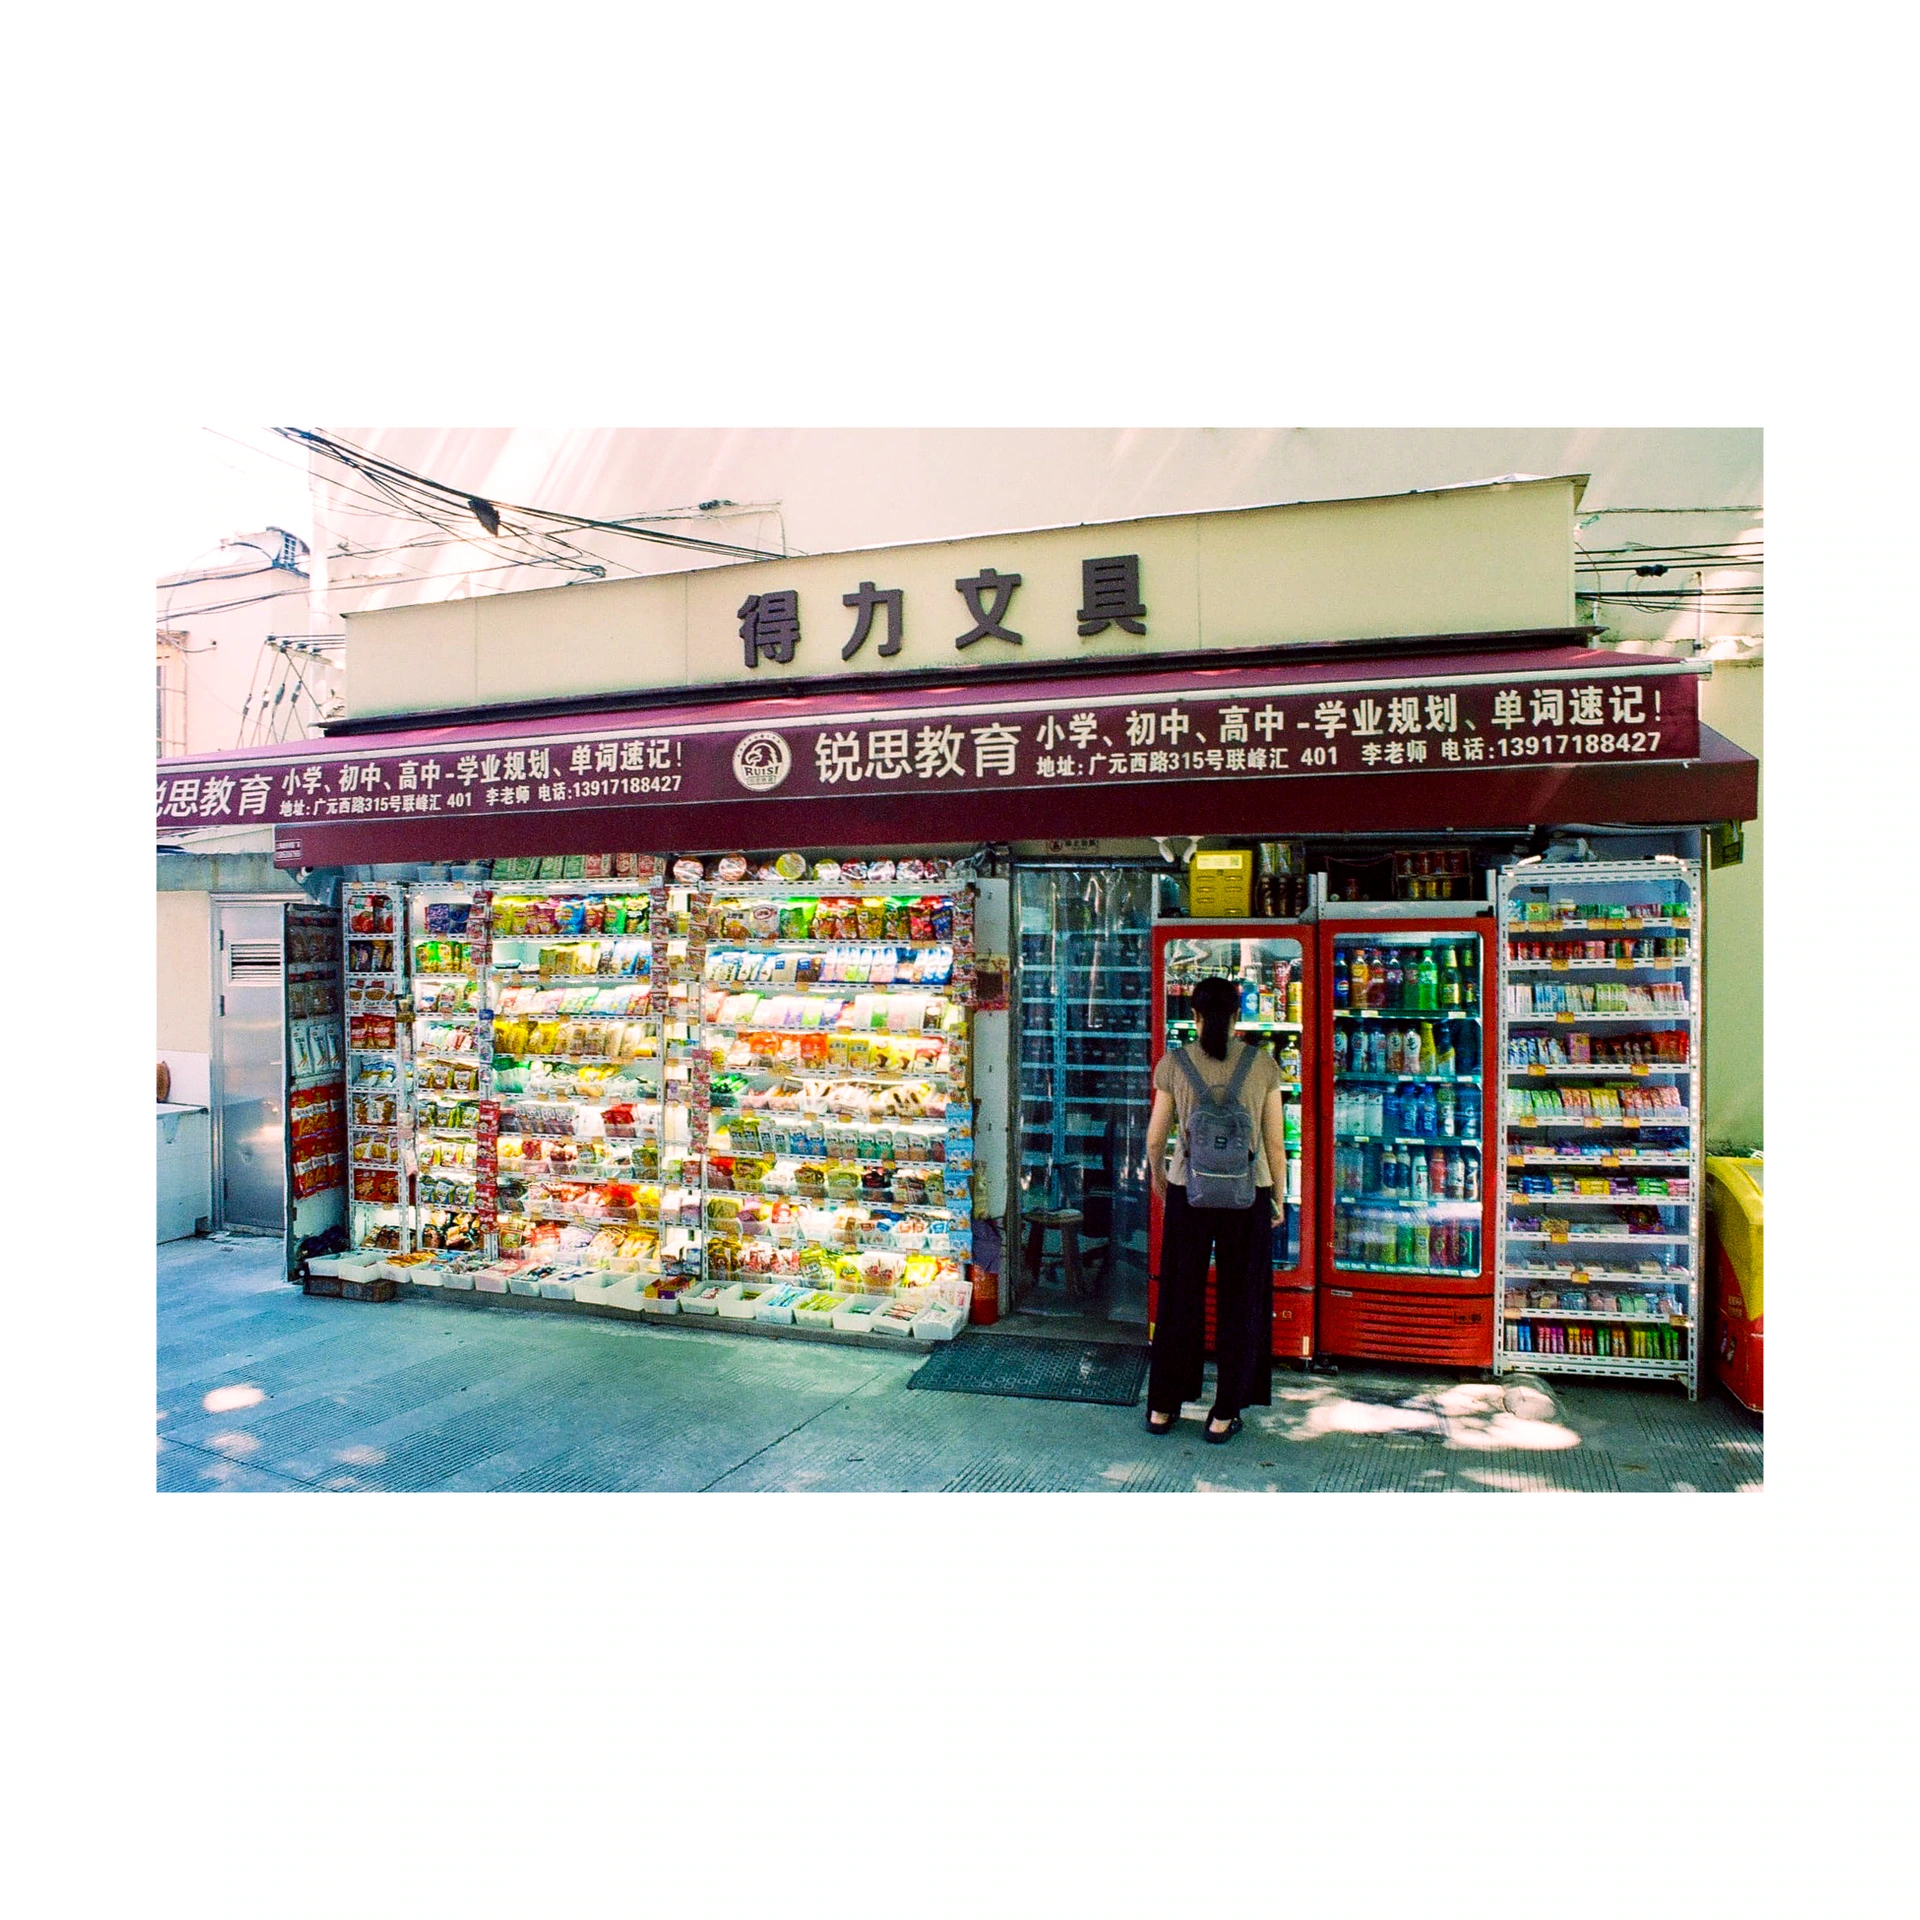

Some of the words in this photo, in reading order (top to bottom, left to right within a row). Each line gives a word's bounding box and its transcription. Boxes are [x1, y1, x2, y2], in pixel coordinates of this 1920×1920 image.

[737, 555, 1147, 668] 得力文具
[744, 765, 780, 777] RUISI
[815, 724, 1021, 784] 锐思教育
[1037, 747, 1289, 777] 地址:广元西路315号联峰汇
[1300, 747, 1337, 766] 401
[1361, 739, 1427, 766] 李老师
[1441, 731, 1661, 762] 电话:13917188427
[446, 792, 472, 809] 401
[485, 784, 530, 805] 李老师
[538, 775, 682, 803] 电话:13917188427
